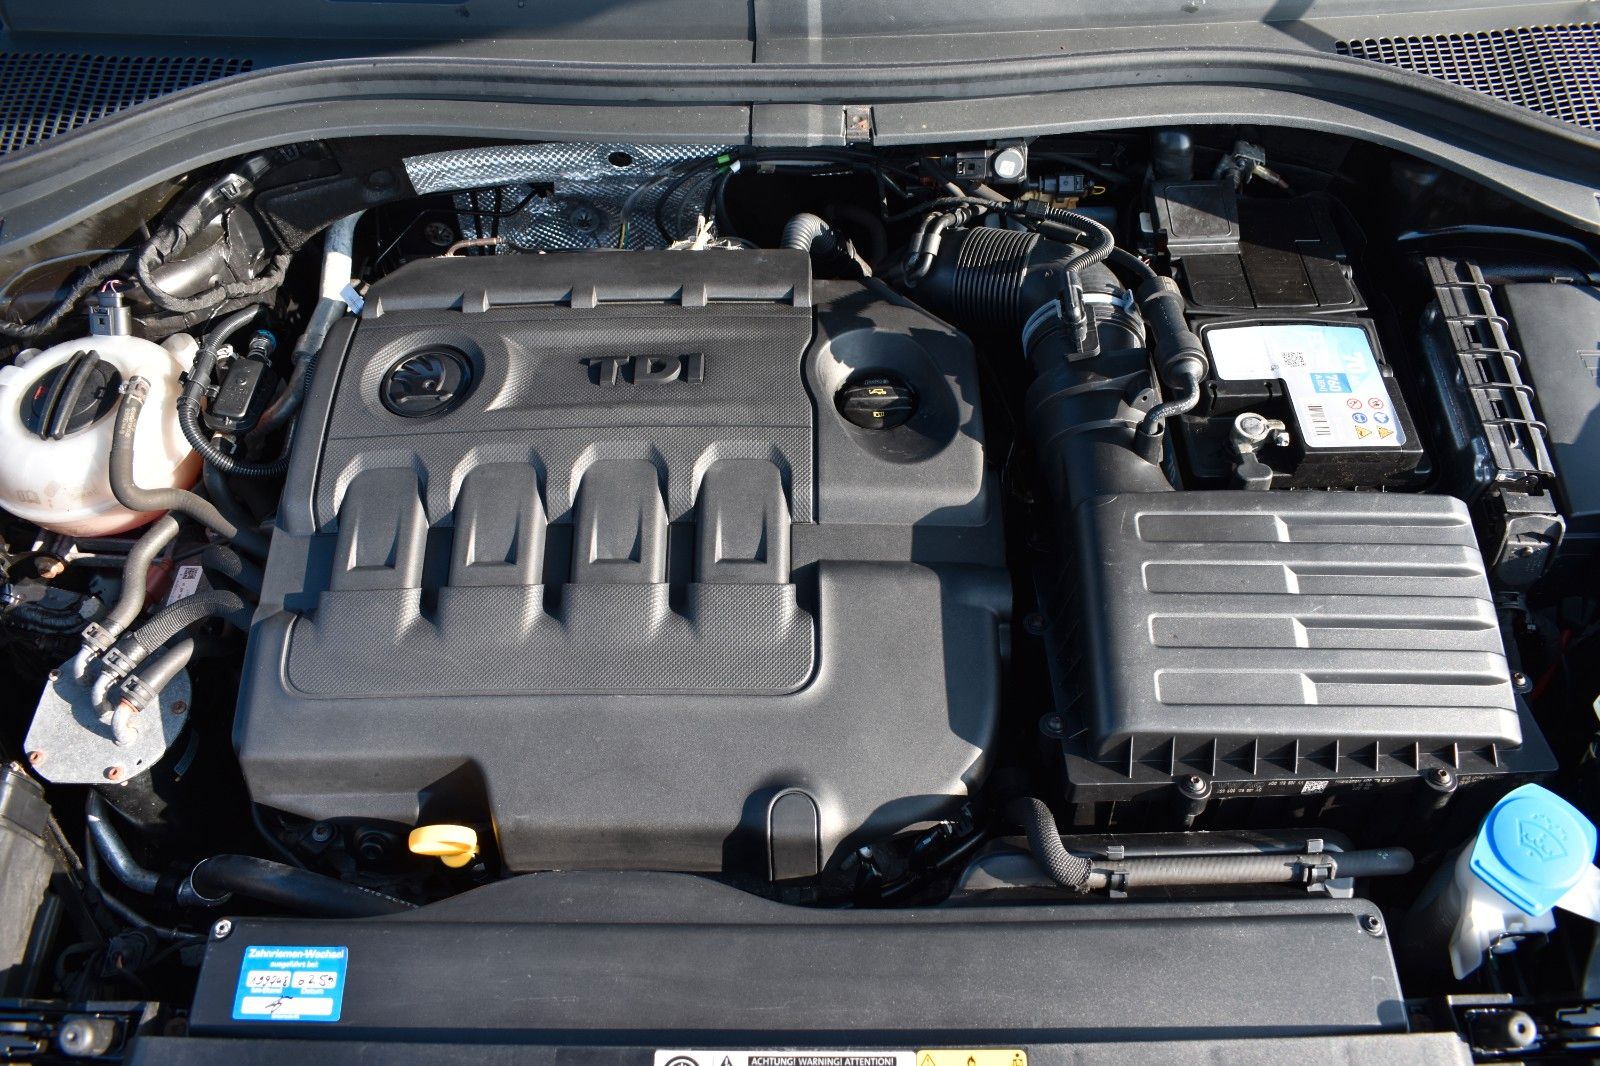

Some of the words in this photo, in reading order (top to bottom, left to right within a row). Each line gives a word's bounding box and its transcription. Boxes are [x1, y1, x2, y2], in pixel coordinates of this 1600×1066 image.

[587, 353, 705, 385] TDI
[1325, 374, 1343, 392] 760
[751, 1057, 796, 1066] ACHTUNG!
[798, 1057, 843, 1066] WARNING!
[844, 1057, 894, 1066] ATTENTION!
